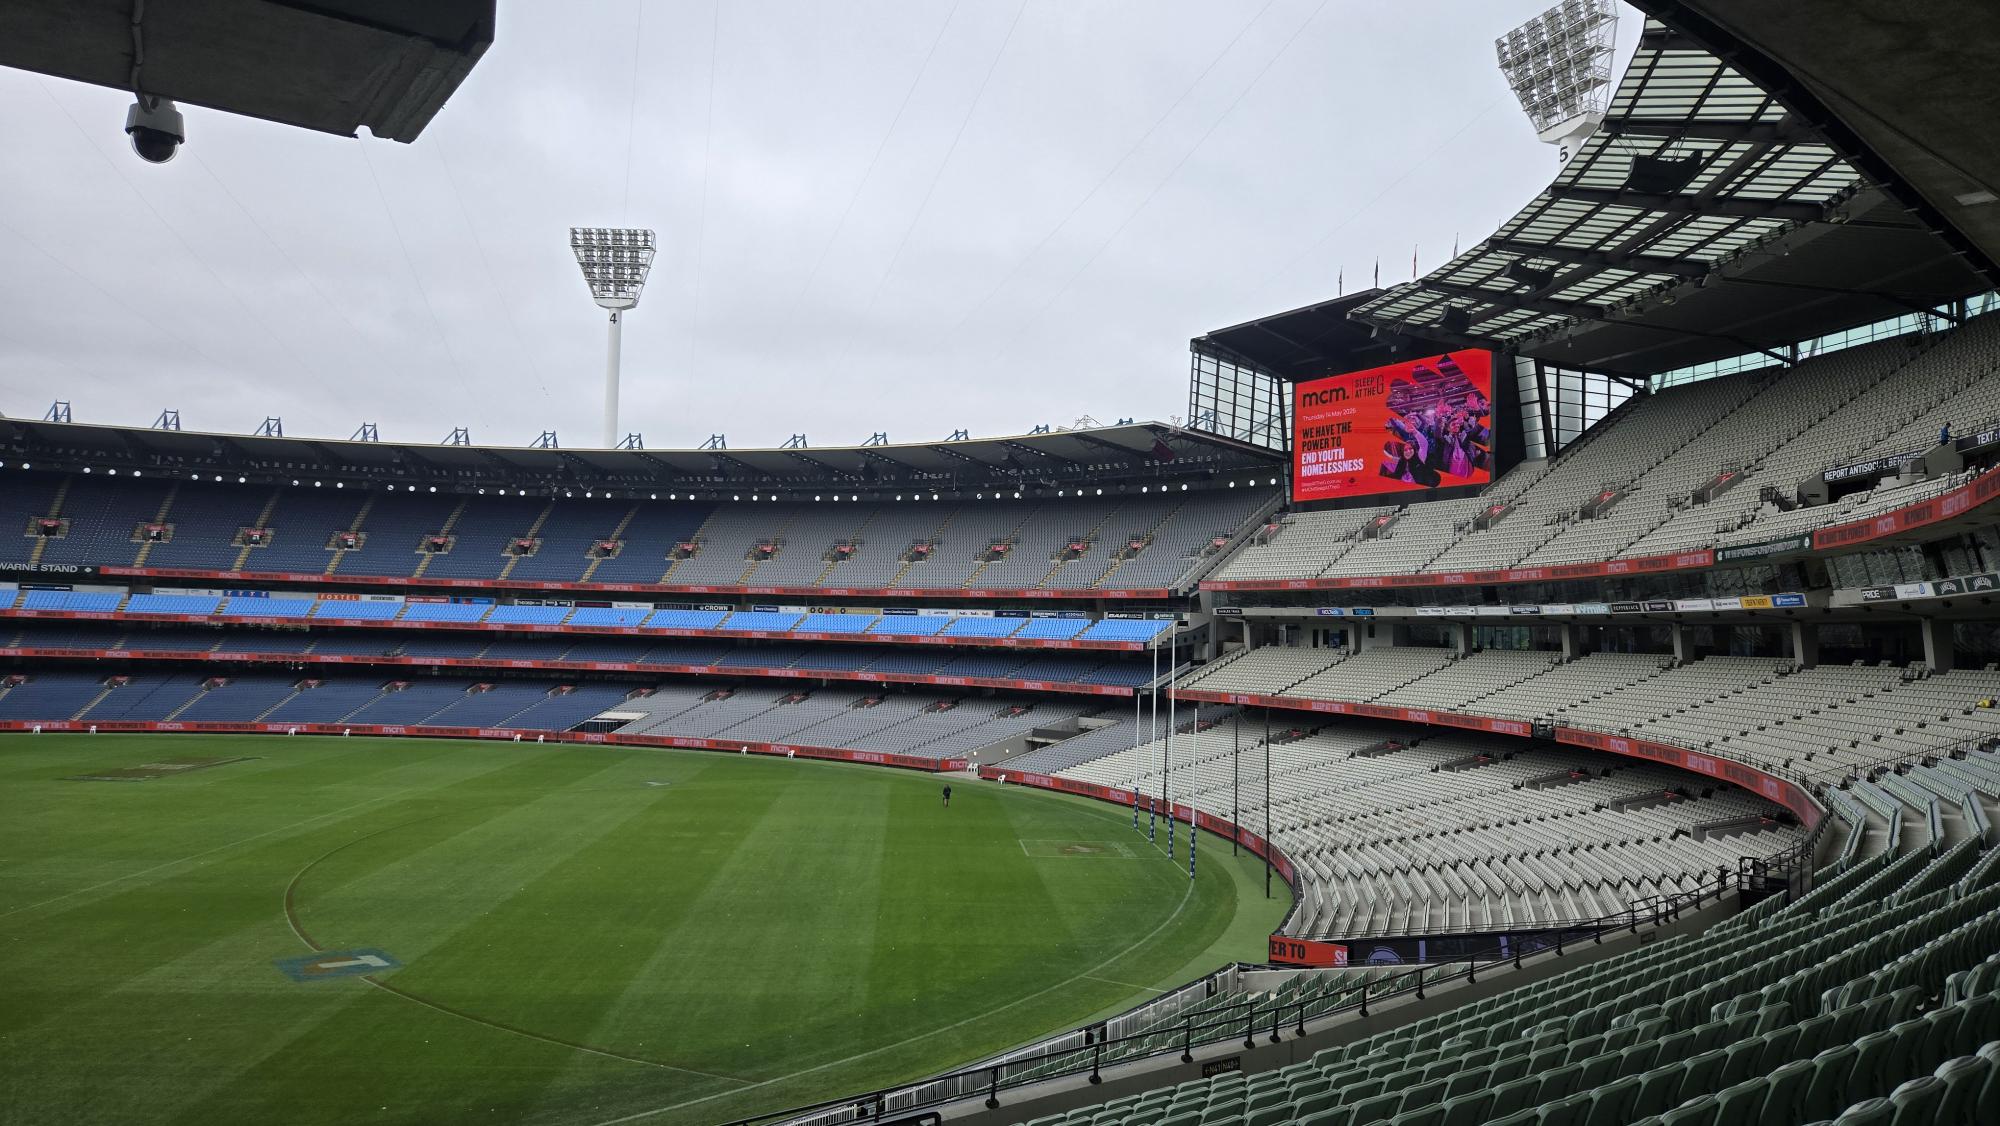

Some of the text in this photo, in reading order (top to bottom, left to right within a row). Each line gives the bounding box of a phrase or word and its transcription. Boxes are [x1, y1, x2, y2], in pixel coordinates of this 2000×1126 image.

[1560, 146, 1568, 162] 5
[610, 312, 618, 324] 4
[1355, 376, 1374, 388] SLEEP
[1355, 389, 1362, 398] AT
[1364, 386, 1376, 396] THE
[1302, 412, 1325, 421] Thursday
[1302, 422, 1352, 439] WE HAVE THE
[1302, 436, 1341, 452] POWER TO
[1977, 432, 1994, 445] TEXT
[1302, 448, 1344, 464] END YOUTH
[1302, 459, 1364, 477] HOMELESSNESS
[1824, 468, 1848, 481] REPORT
[0, 563, 78, 573] WARNE STAND
[1862, 590, 1880, 599] PRIDE
[1290, 942, 1306, 959] TO
